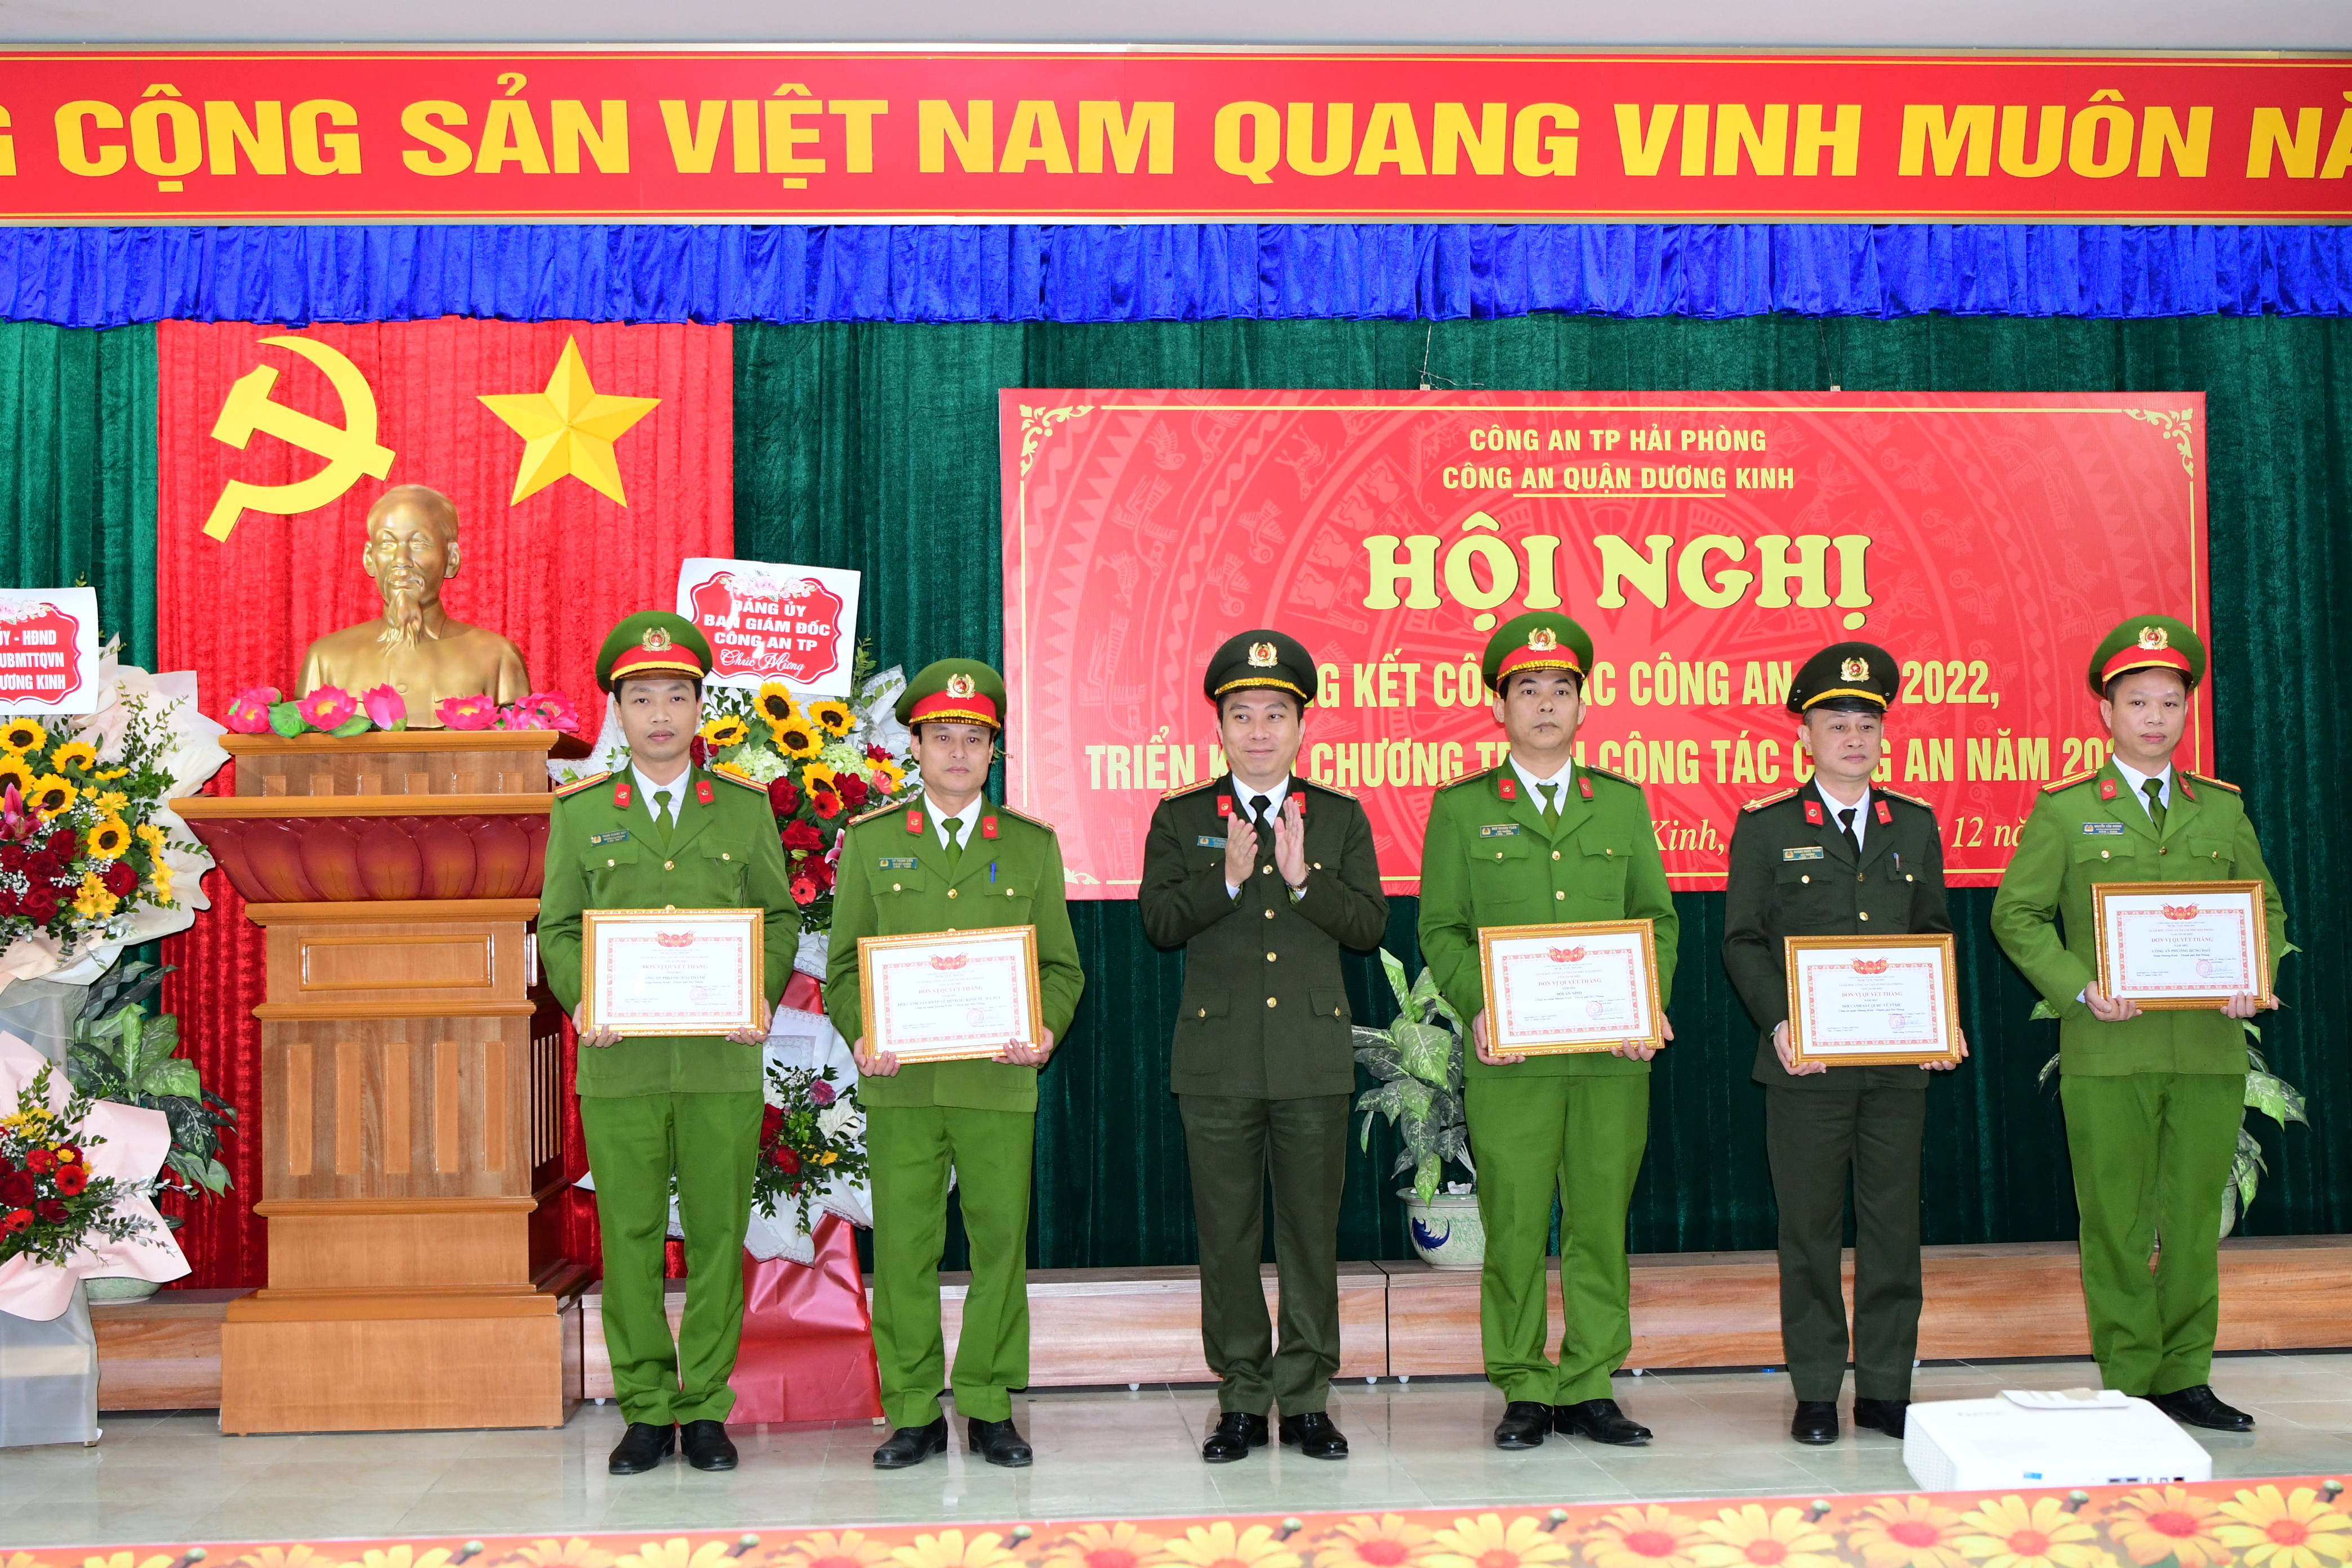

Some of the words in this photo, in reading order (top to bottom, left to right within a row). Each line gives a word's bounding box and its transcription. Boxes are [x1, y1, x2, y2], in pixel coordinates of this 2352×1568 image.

[54, 83, 362, 192] CỘNG
[400, 72, 630, 176] SẢN
[658, 83, 889, 189] VIỆT
[918, 99, 1175, 174] NAM
[1213, 100, 1580, 185] QUANG
[1613, 104, 1863, 177] VINH
[1898, 89, 2214, 178] MUÔN
[1469, 424, 1539, 452] CÔNG
[1548, 429, 1580, 451] AN
[1589, 429, 1621, 451] TP
[1630, 422, 1672, 452] HẢI
[1681, 424, 1766, 452] PHÒNG
[1442, 461, 1512, 489] CÔNG
[1521, 467, 1554, 489] AN
[1563, 462, 1631, 493] QUẬN
[1641, 464, 1726, 489] DƯƠNG
[1736, 467, 1794, 489] KINH
[1362, 510, 1563, 631] HỘI
[1593, 533, 1873, 631] NGHỊ
[731, 597, 779, 615] ĐẢNG
[785, 601, 807, 617] ỦY
[23, 630, 57, 645] HĐND
[714, 631, 762, 648] CÔNG
[767, 636, 792, 650] AN
[796, 639, 818, 652] TP
[745, 617, 791, 633] GIÁM
[795, 620, 831, 636] ĐỐC
[36, 674, 66, 690] KINH
[1353, 648, 1420, 708] KẾT
[1629, 651, 1730, 706] CÔNG
[1741, 661, 1793, 705] AN
[1901, 660, 1999, 710] 2022,
[1085, 725, 1196, 790] TRIỂN
[1310, 737, 1464, 787] CHƯƠNG
[1599, 730, 1700, 785] CÔNG
[1710, 729, 1780, 784] TÁC
[1904, 738, 1954, 782] AN
[1967, 728, 2050, 781] NĂM
[1950, 816, 1984, 847] 12
